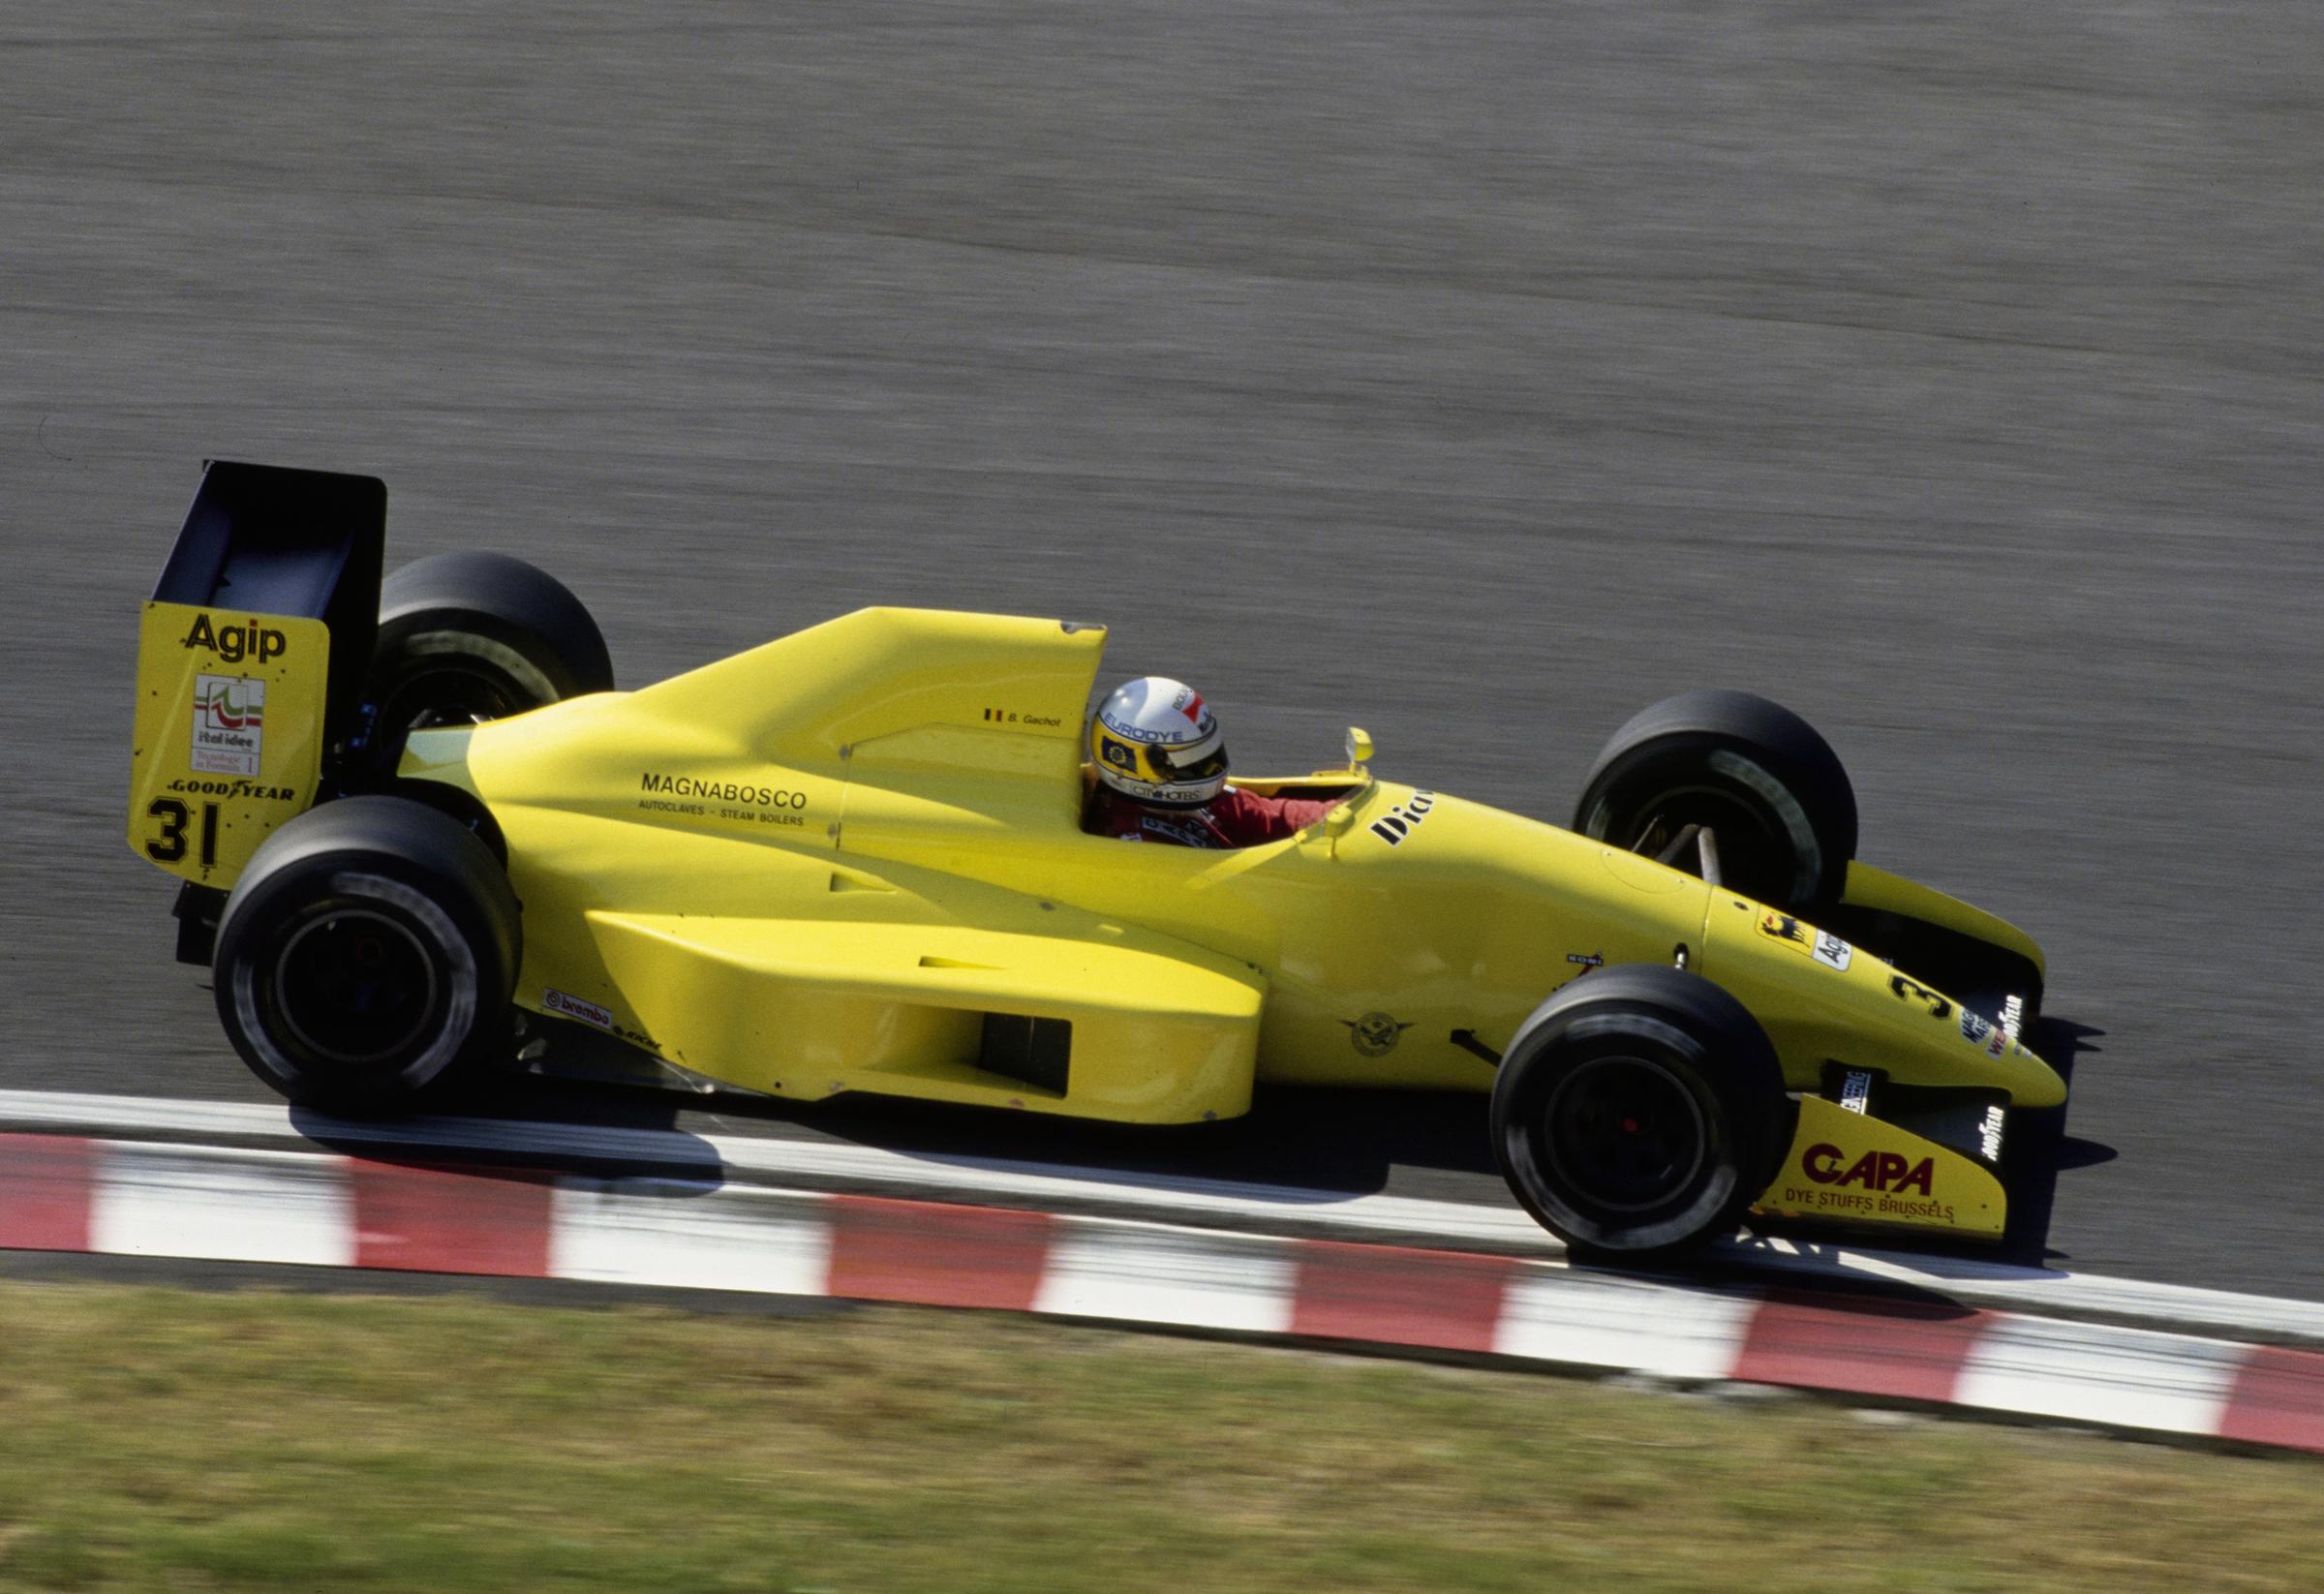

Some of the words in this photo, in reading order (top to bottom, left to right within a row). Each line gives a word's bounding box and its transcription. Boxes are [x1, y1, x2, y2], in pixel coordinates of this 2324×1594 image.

[185, 614, 286, 663] Agip
[1104, 713, 1183, 742] EURODYE
[641, 773, 807, 810] MAGNABOSCO
[639, 800, 705, 815] AUTOCLAVES
[720, 810, 755, 821] STEAM
[759, 813, 805, 827] BOILERS
[146, 797, 219, 868] 31
[562, 996, 610, 1025] brembo
[1988, 1030, 2006, 1056] WE
[1802, 1143, 1935, 1197] CAPA
[1786, 1188, 1814, 1204] DYE
[1819, 1192, 1874, 1211] STUFFS
[1879, 1199, 1954, 1218] BRUSSELS
